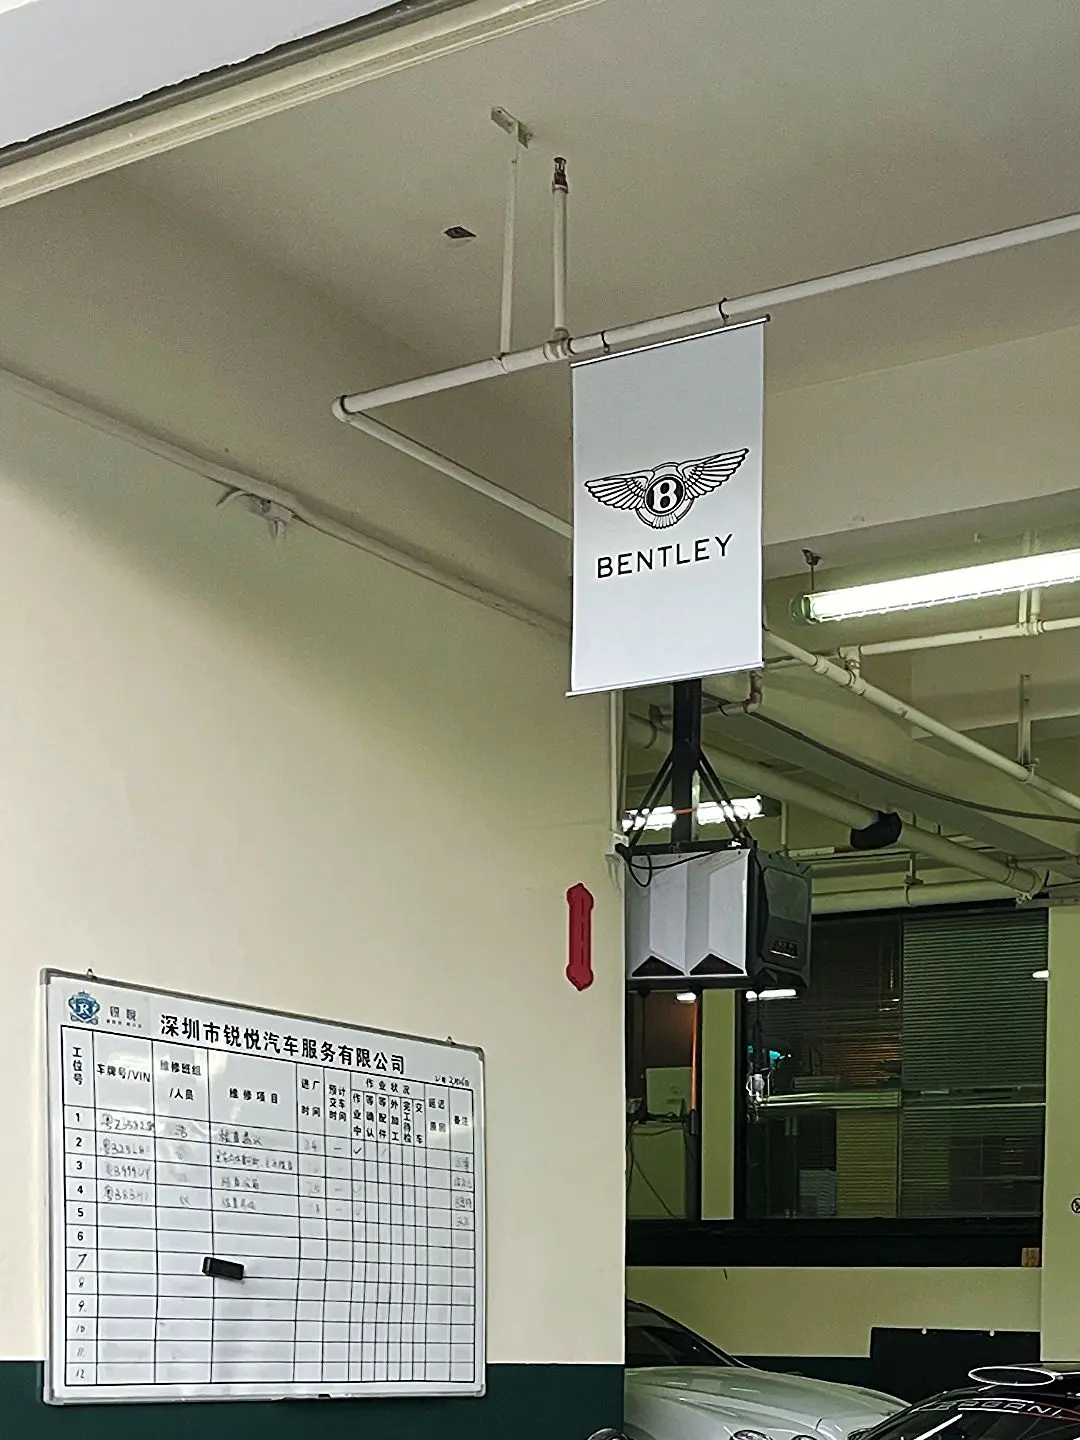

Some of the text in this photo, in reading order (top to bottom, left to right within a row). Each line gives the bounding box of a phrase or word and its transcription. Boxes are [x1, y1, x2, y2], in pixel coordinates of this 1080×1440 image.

[597, 533, 732, 578] BENTLEY
[160, 1014, 404, 1074] 深圳市锐悦汽车服务有限公司
[73, 1047, 83, 1085] 工位号
[229, 1088, 278, 1104] 维修项目
[75, 1112, 81, 1122] 1
[75, 1137, 83, 1147] 2
[76, 1160, 83, 1170] 3
[76, 1185, 84, 1194] 4
[77, 1207, 84, 1217] 5
[77, 1231, 84, 1241] 6
